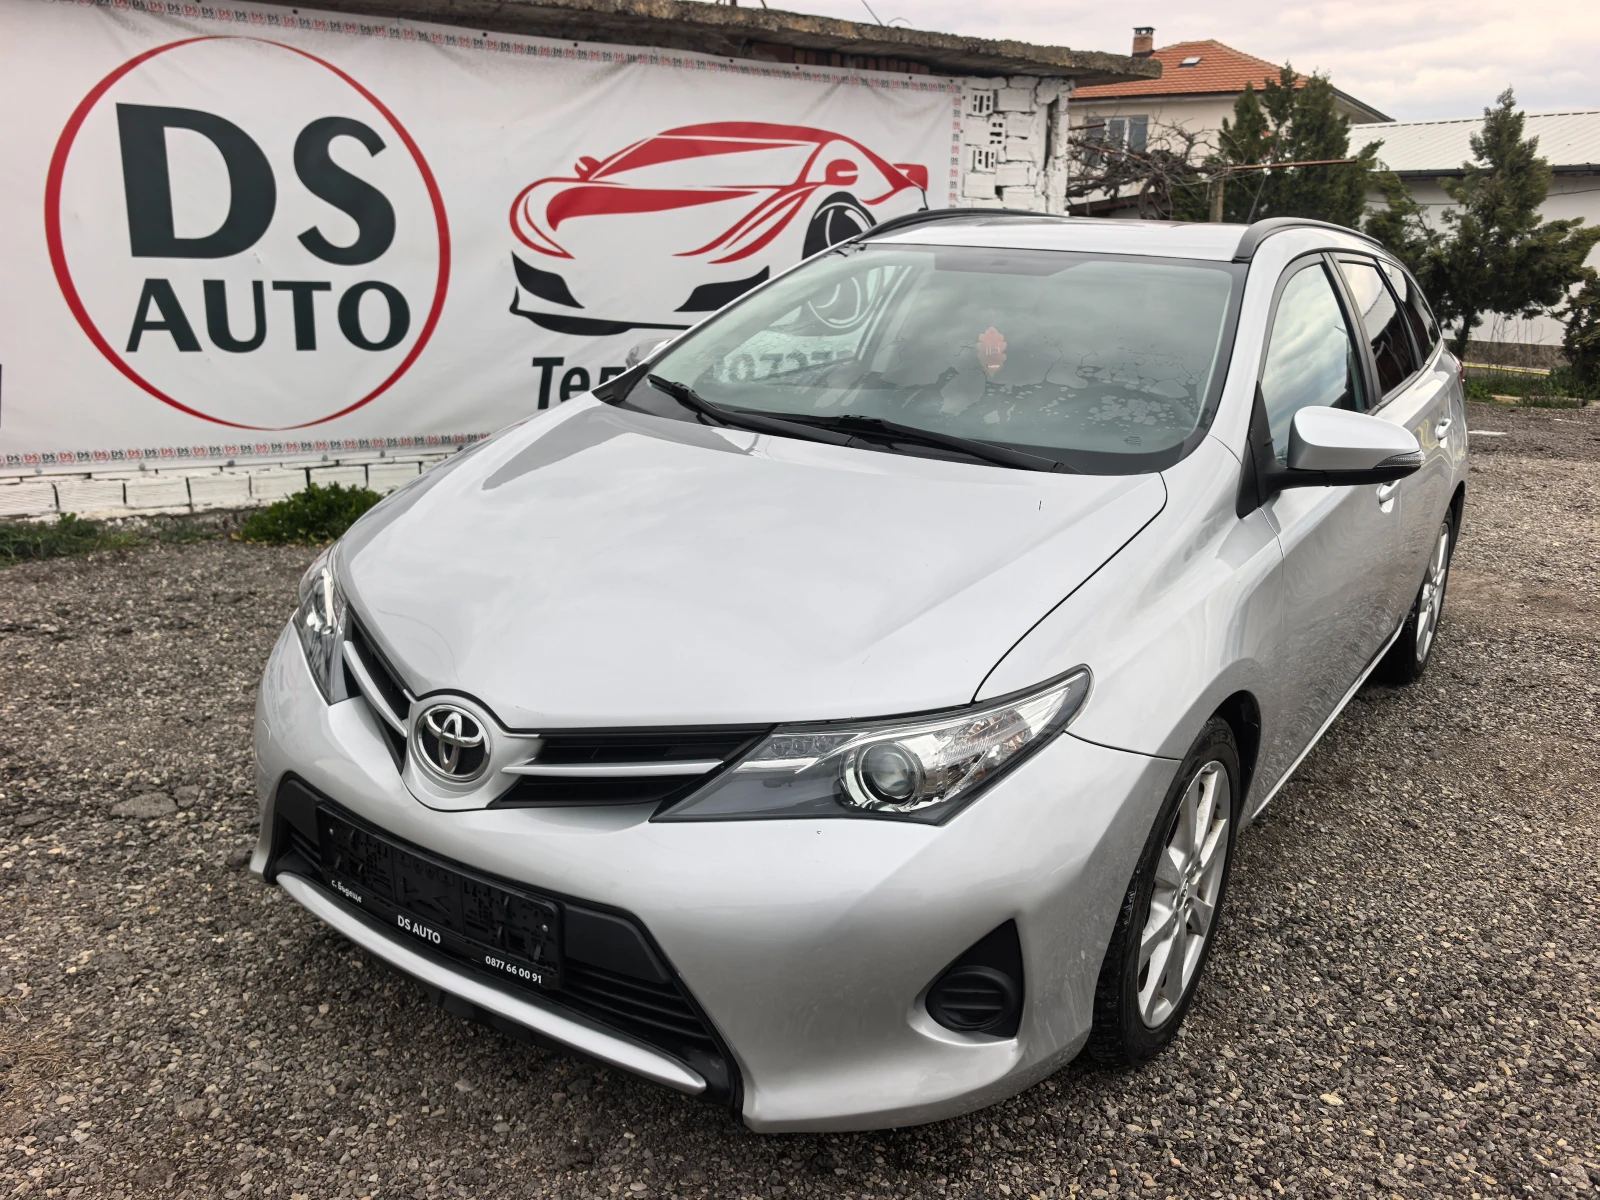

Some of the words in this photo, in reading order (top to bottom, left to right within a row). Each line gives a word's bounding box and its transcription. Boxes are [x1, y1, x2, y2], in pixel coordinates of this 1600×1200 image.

[116, 102, 397, 266] DS
[125, 277, 411, 354] AUTO
[94, 450, 106, 458] DS
[398, 914, 410, 930] DS
[412, 922, 441, 944] AUTO
[486, 956, 504, 970] 0877
[506, 965, 517, 975] 66
[518, 968, 530, 980] 00
[532, 974, 542, 984] 91
